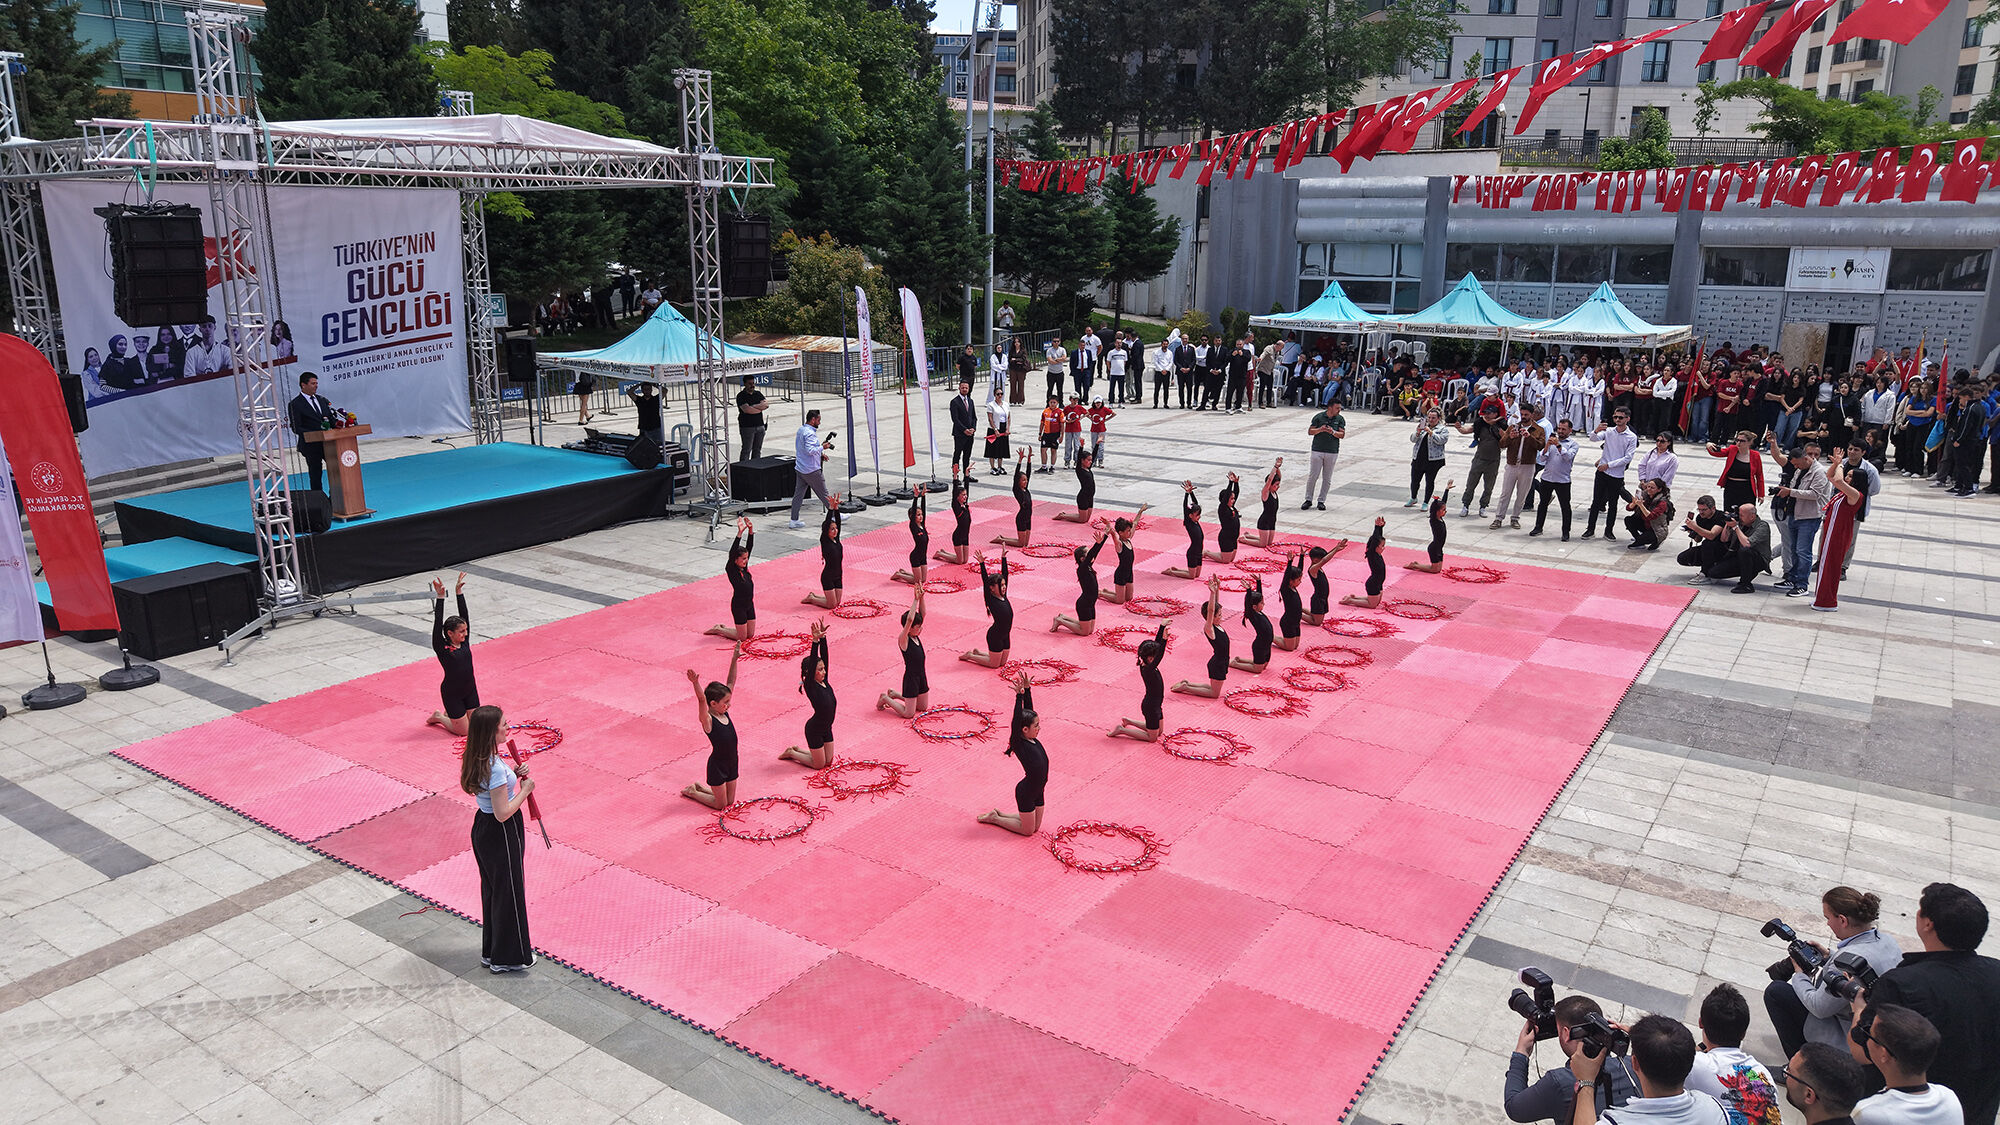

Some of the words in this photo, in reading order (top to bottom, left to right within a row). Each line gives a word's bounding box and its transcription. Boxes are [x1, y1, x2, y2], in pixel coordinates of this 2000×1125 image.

[333, 231, 436, 267] TÜRKİYE'NİN
[347, 258, 425, 304] GÜCÜ
[321, 291, 453, 348] GENÇLİĞİ
[322, 365, 331, 373] 19
[332, 360, 354, 371] MAYIS
[356, 350, 392, 366] ATATÜRK'Ü
[394, 348, 413, 358] ANMA
[415, 343, 443, 354] GENÇLİK
[333, 370, 351, 381] SPOR
[353, 360, 395, 378] BAYRAMIMIZ
[397, 358, 418, 369] KUTLU
[420, 354, 445, 365] OLSUN!
[753, 356, 774, 369] Belediyesi
